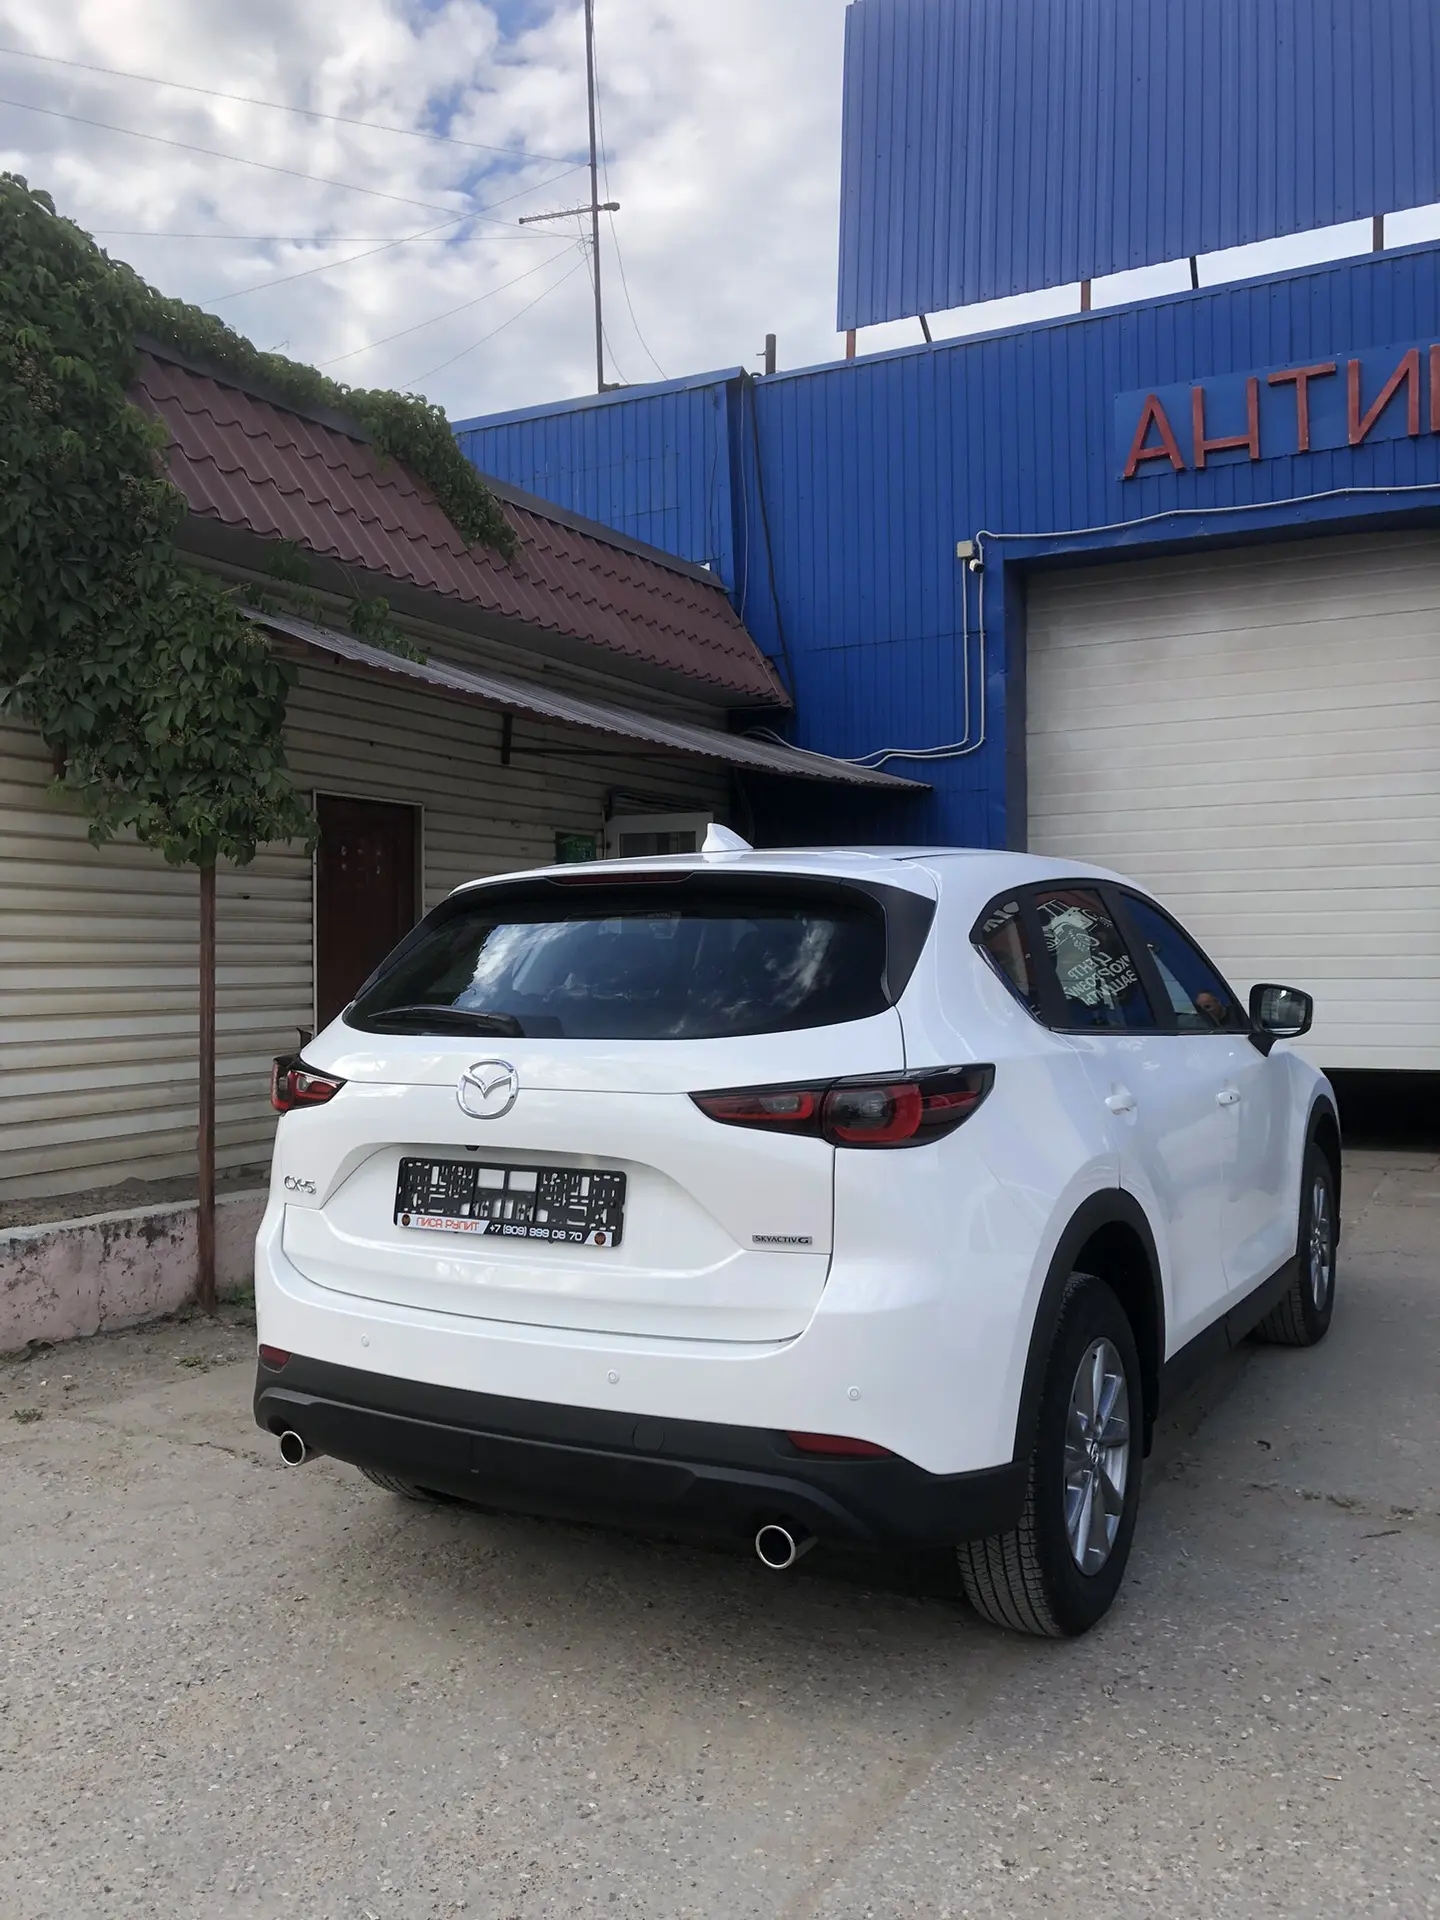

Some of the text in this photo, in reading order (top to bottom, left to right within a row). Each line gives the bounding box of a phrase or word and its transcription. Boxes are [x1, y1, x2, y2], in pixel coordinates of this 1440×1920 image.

[1123, 344, 1440, 480] АНТИ
[284, 1175, 317, 1195] CX-5
[489, 1224, 501, 1233] +7
[568, 1231, 583, 1241] 70
